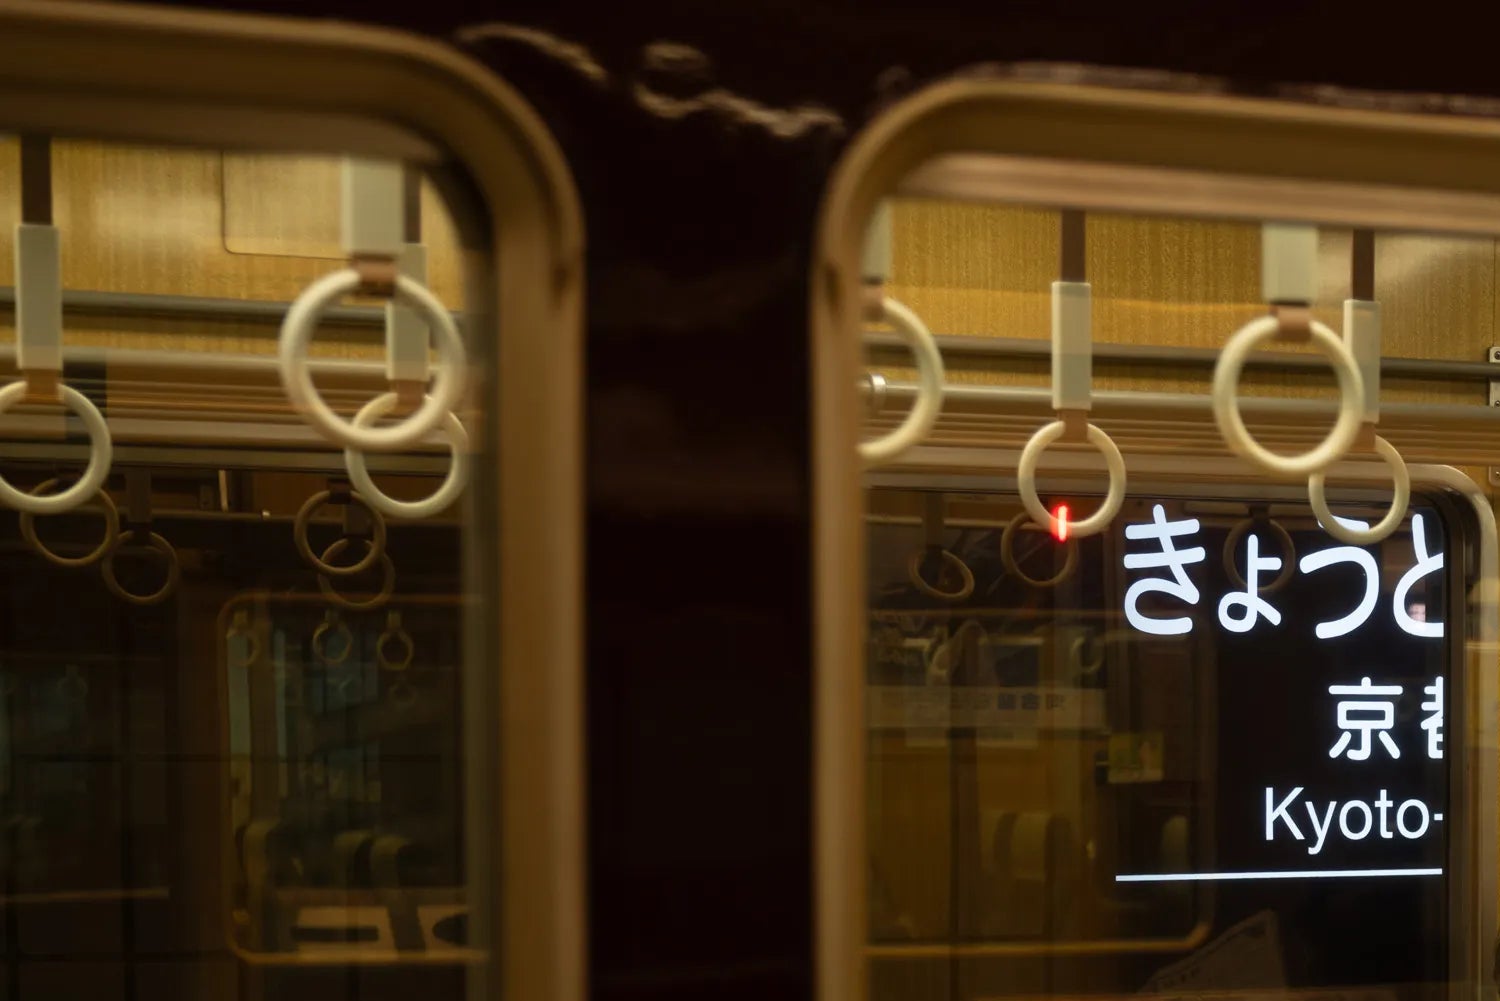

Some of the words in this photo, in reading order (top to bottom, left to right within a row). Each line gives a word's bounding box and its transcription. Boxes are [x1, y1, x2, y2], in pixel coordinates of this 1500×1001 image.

[1123, 504, 1444, 640] きょうと
[1265, 787, 1443, 855] Kyoto-
